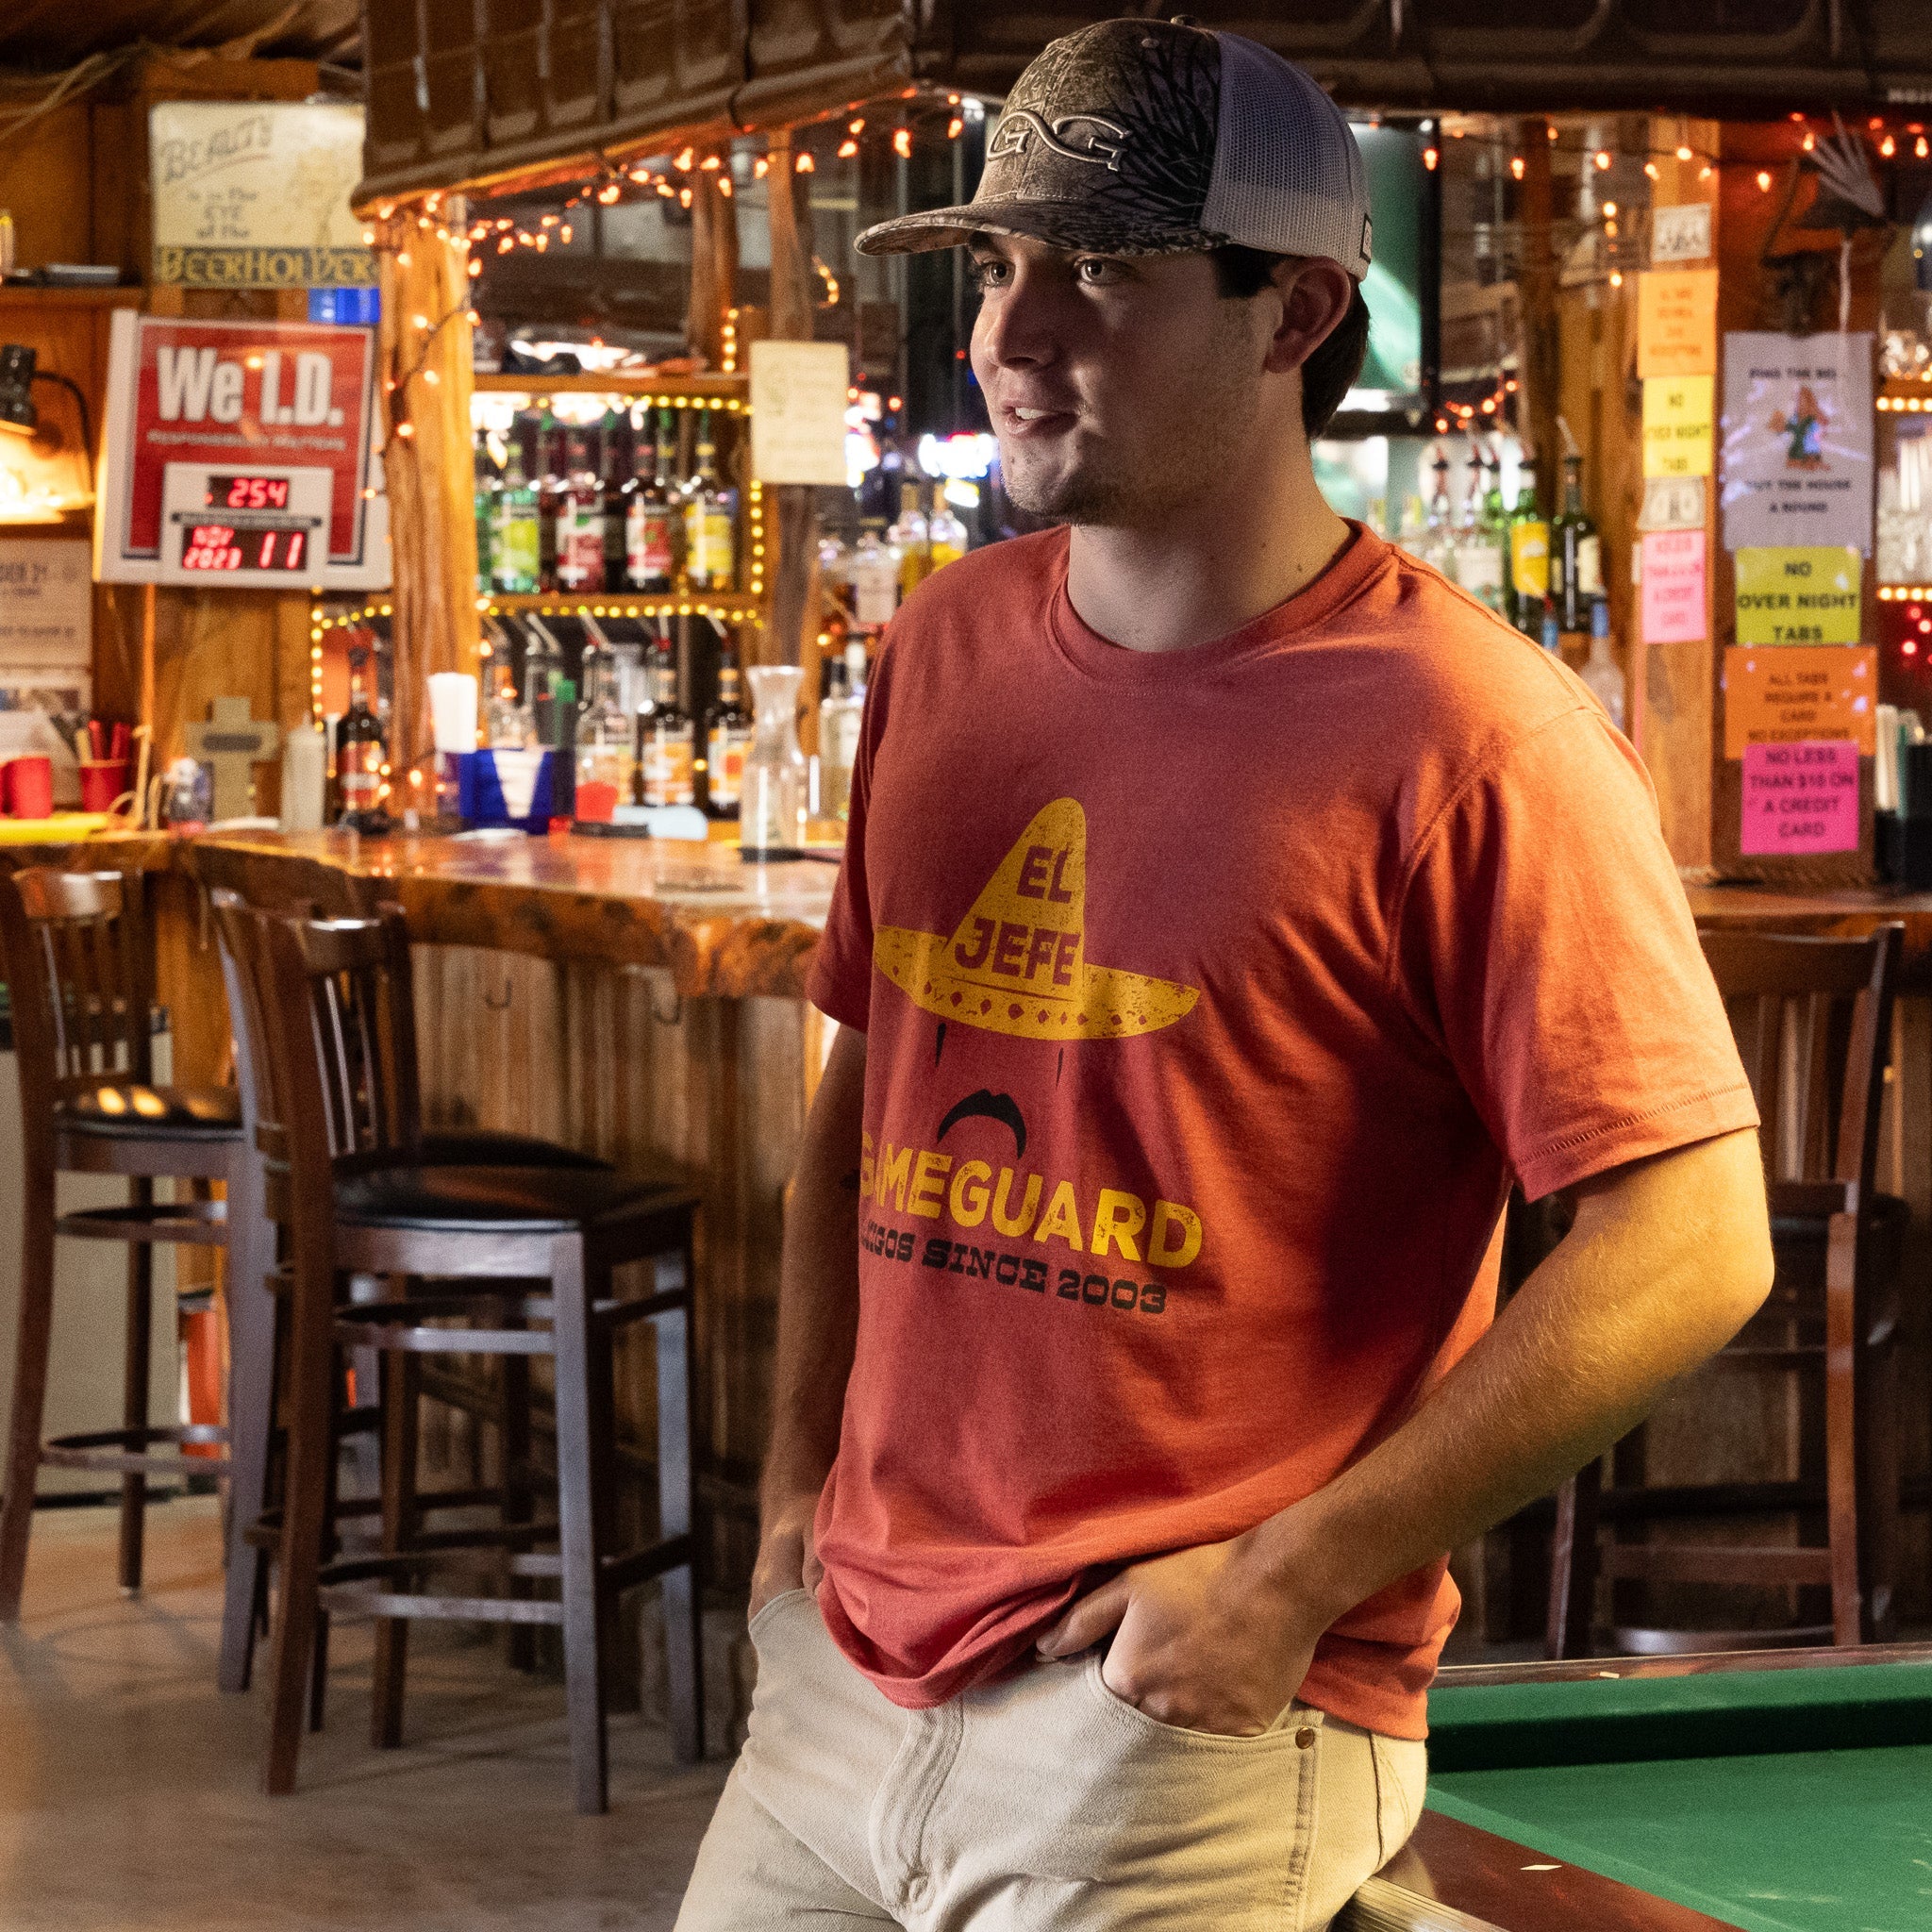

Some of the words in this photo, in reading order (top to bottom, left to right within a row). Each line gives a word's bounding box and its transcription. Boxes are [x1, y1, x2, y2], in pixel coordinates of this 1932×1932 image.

[157, 345, 244, 424] We
[259, 350, 345, 427] I.D.
[1785, 561, 1811, 577] NO
[1738, 593, 1790, 610] OVER
[1797, 592, 1857, 609] NIGHT
[1774, 625, 1823, 641] TABS
[1765, 749, 1790, 765] NO
[1794, 747, 1837, 765] LESS
[1751, 774, 1793, 789] THAN
[1830, 772, 1854, 788] ON
[1763, 798, 1774, 813] A
[1779, 795, 1839, 813] CREDIT
[1778, 821, 1825, 839] CARD
[1016, 843, 1074, 904] EL
[954, 917, 1081, 986] JEFE
[922, 1239, 1049, 1293] SINCE
[1056, 1269, 1168, 1315] 2003
